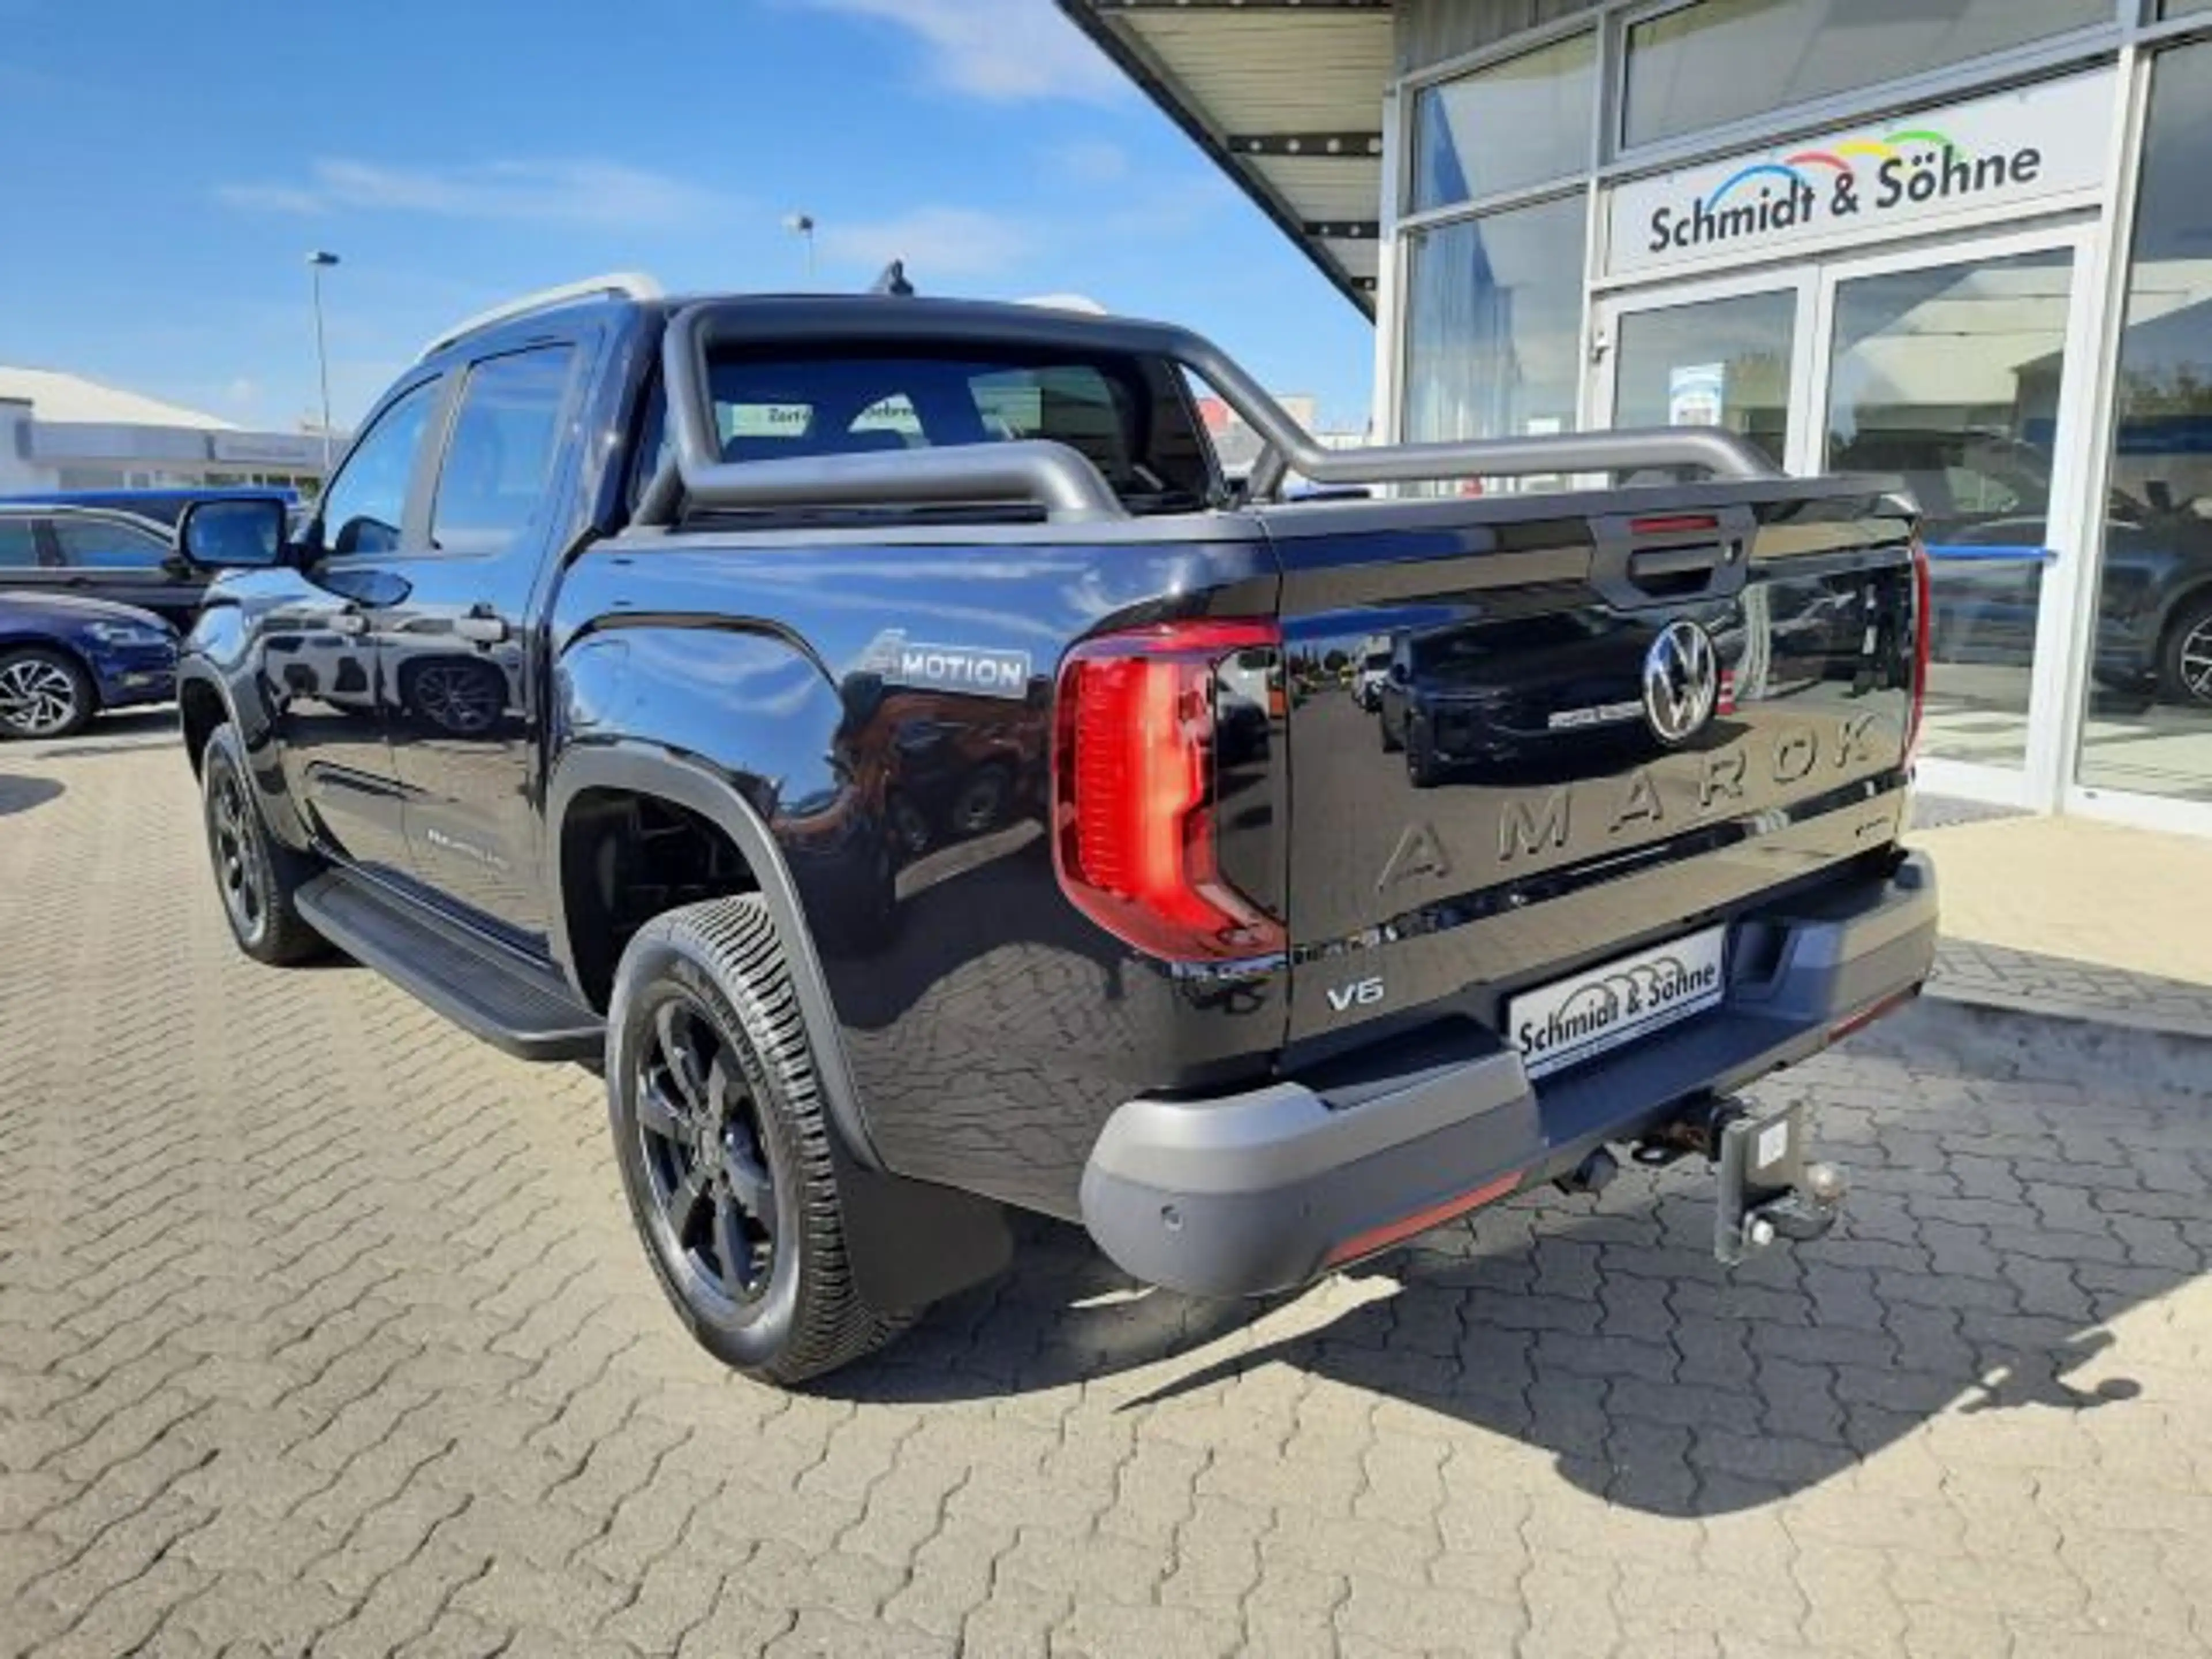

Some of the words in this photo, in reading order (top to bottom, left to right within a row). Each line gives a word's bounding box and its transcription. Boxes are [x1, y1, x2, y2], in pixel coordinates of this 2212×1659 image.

[1649, 175, 1816, 252] Schmidt
[1831, 173, 1859, 217] &
[1876, 144, 2041, 209] Söhne
[1378, 712, 1880, 896] AMAROK
[1327, 976, 1384, 1010] V6
[1520, 992, 1619, 1054] Schmidt
[1627, 987, 1643, 1014] &
[1648, 963, 1716, 1007] Söhne
